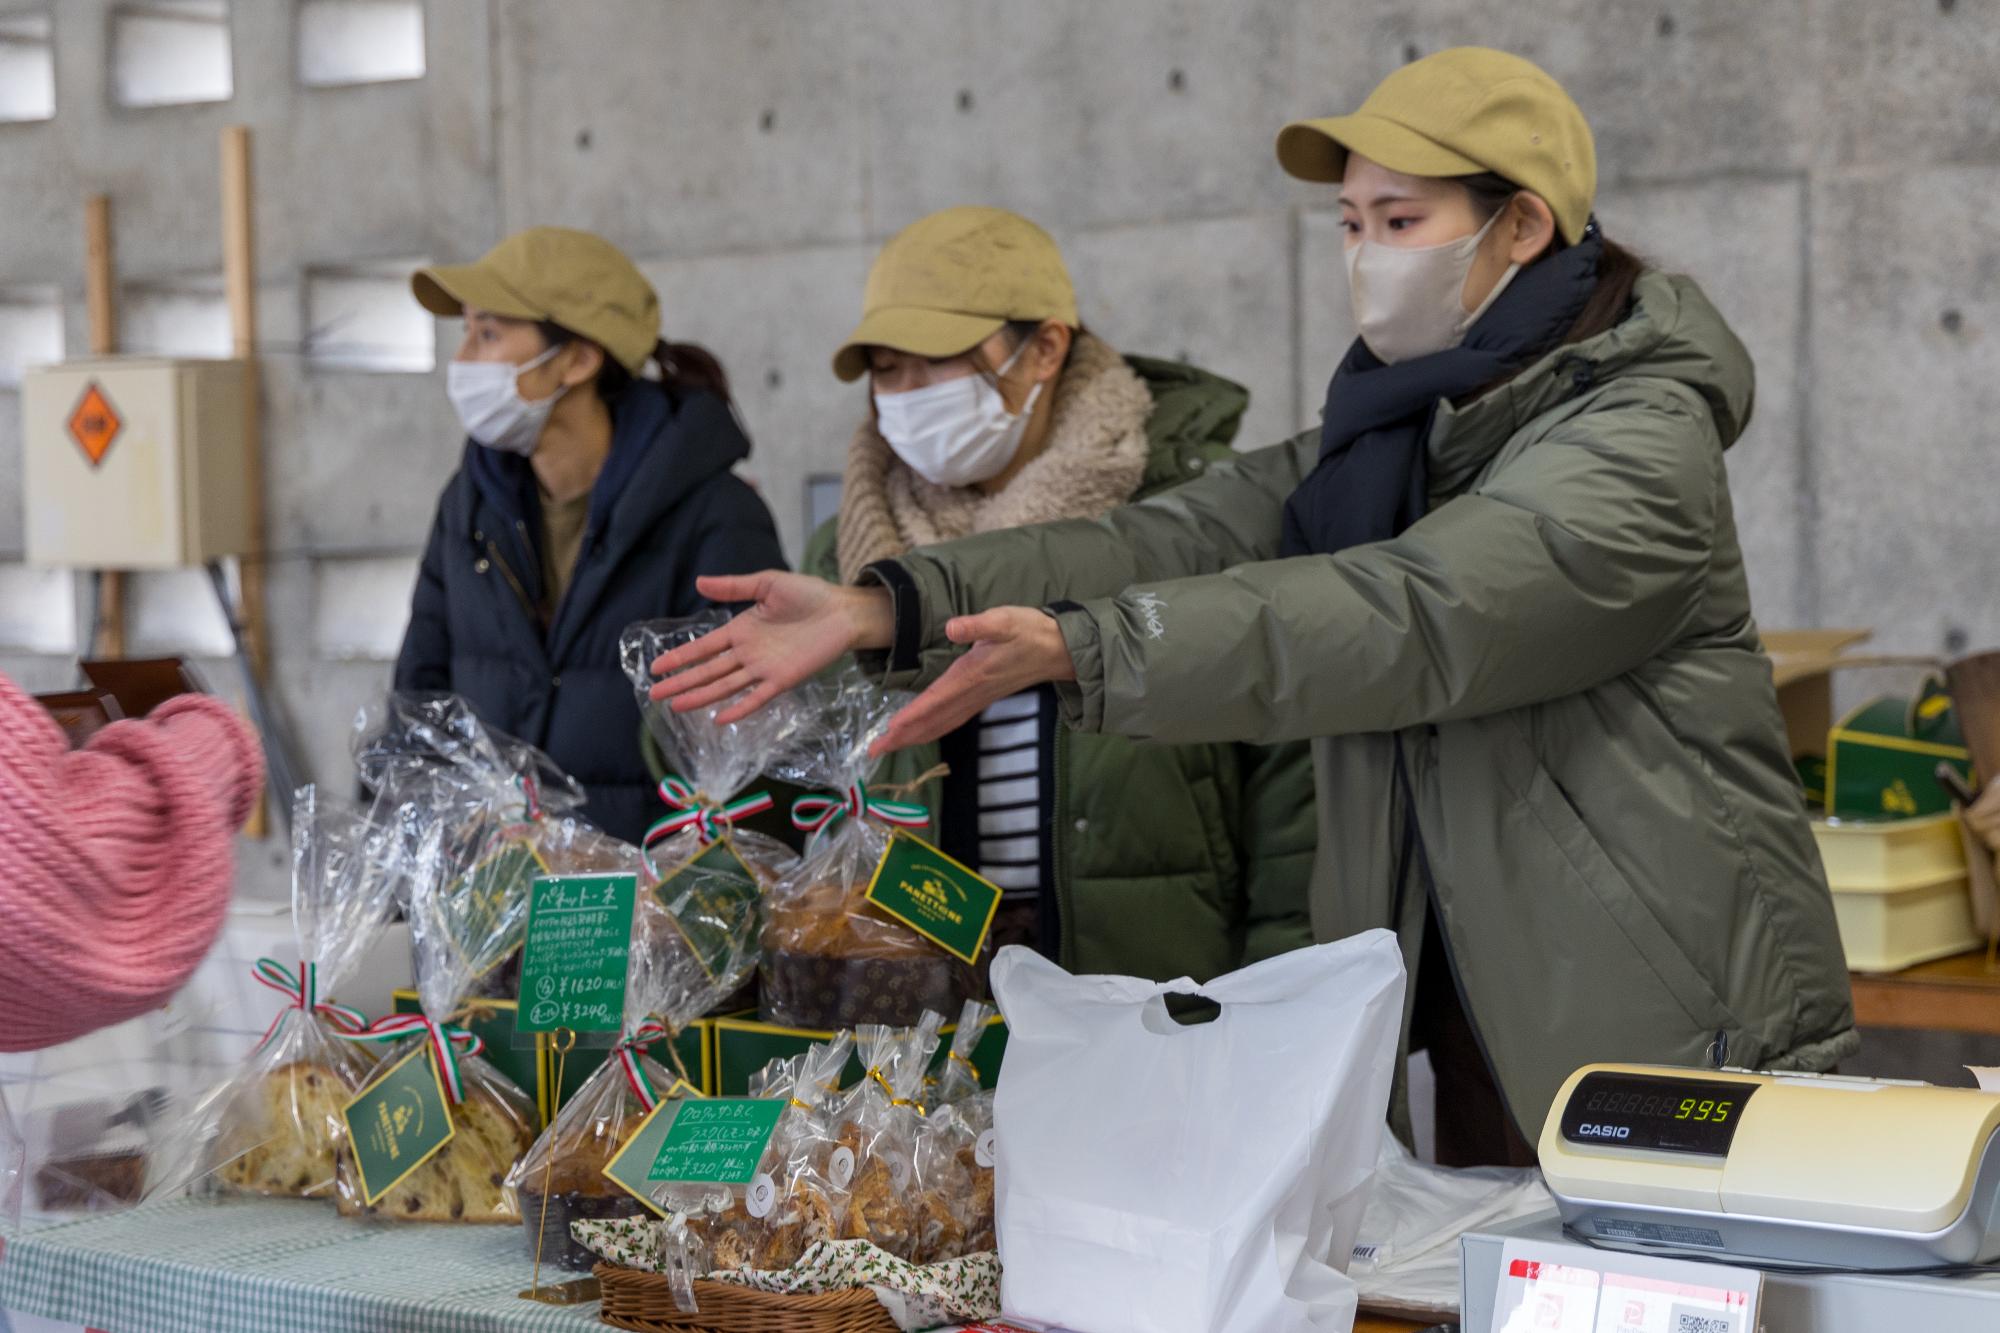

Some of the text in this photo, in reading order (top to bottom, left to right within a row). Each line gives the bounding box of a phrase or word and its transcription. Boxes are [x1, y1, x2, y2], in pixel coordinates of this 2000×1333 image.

[899, 880, 963, 924] PANETTONE
[559, 976, 602, 997] ¥1620
[562, 1001, 607, 1022] ¥3240
[1675, 1098, 1733, 1122] 995
[1579, 1123, 1630, 1138] CASIO
